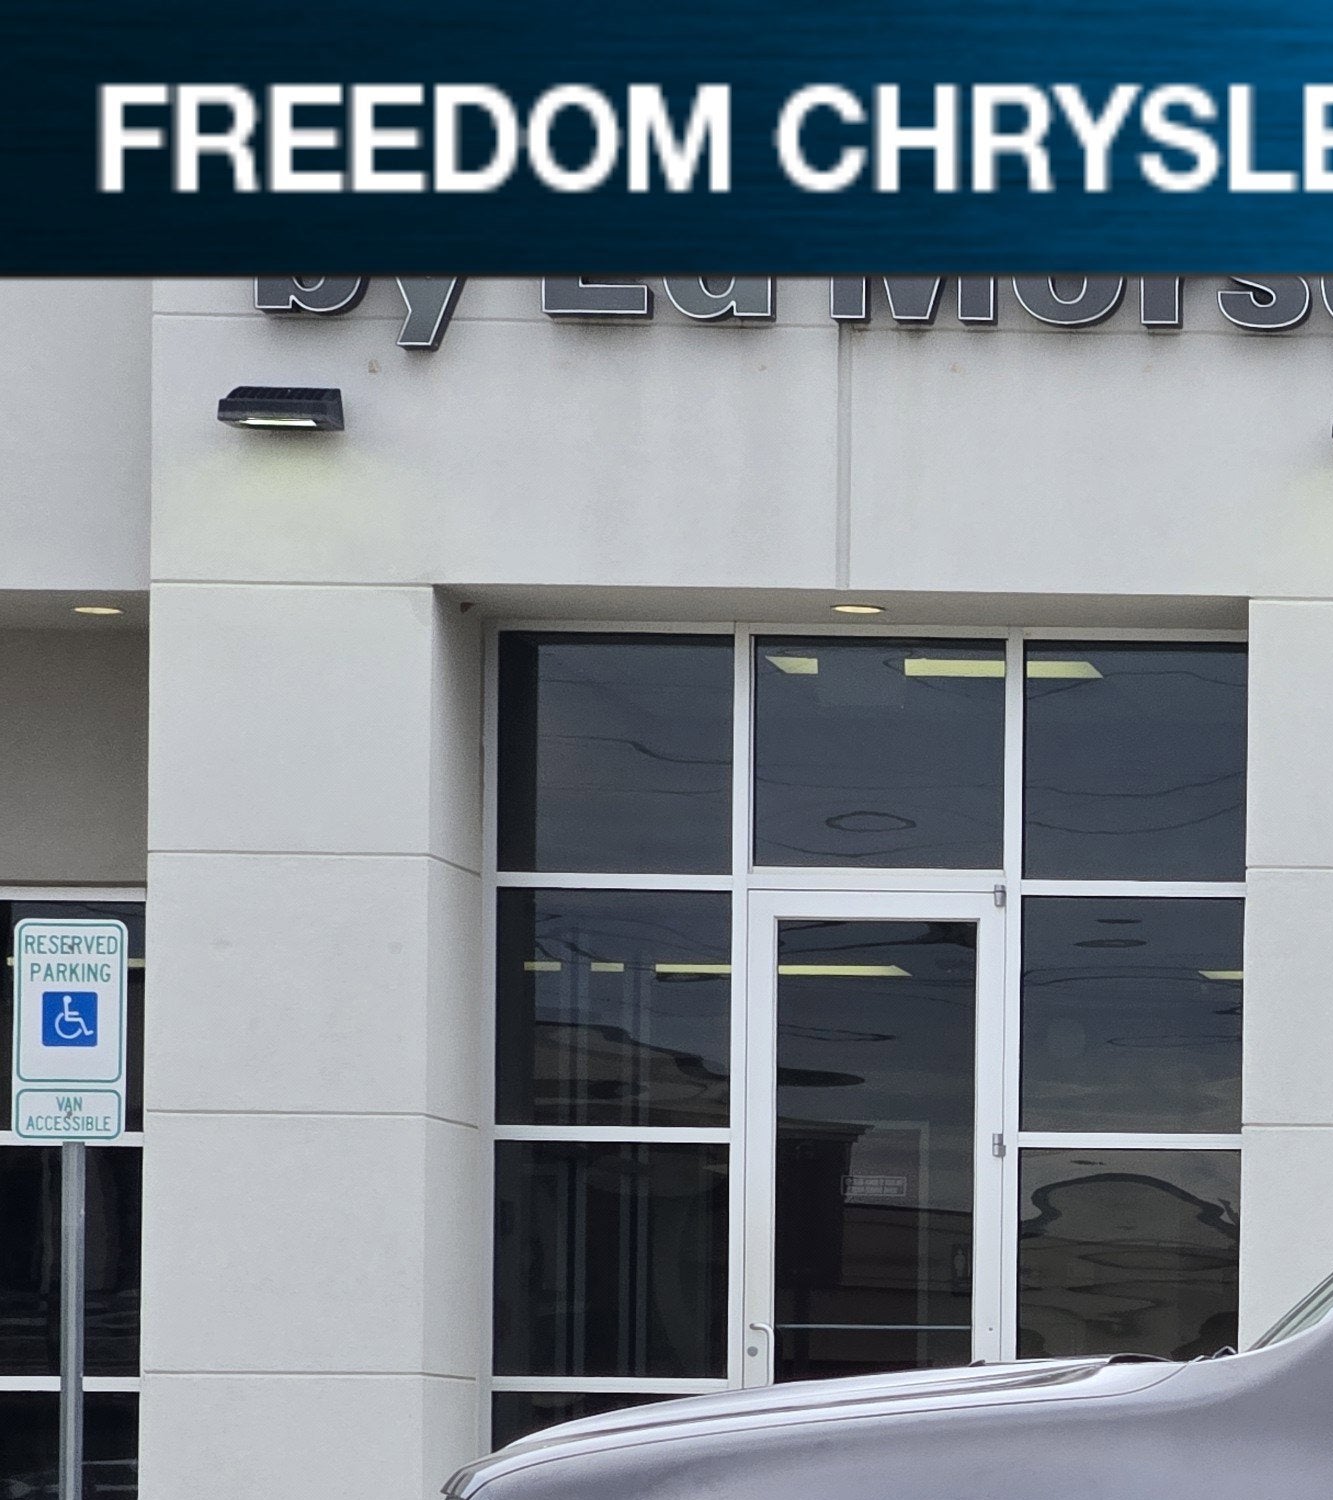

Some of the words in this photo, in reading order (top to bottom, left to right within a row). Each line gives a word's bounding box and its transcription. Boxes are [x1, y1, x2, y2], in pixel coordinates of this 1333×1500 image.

[24, 935, 118, 955] RESERVED
[30, 963, 111, 983] PARKING
[56, 1097, 83, 1111] VAN
[26, 1116, 111, 1132] ACCESSIBLE
